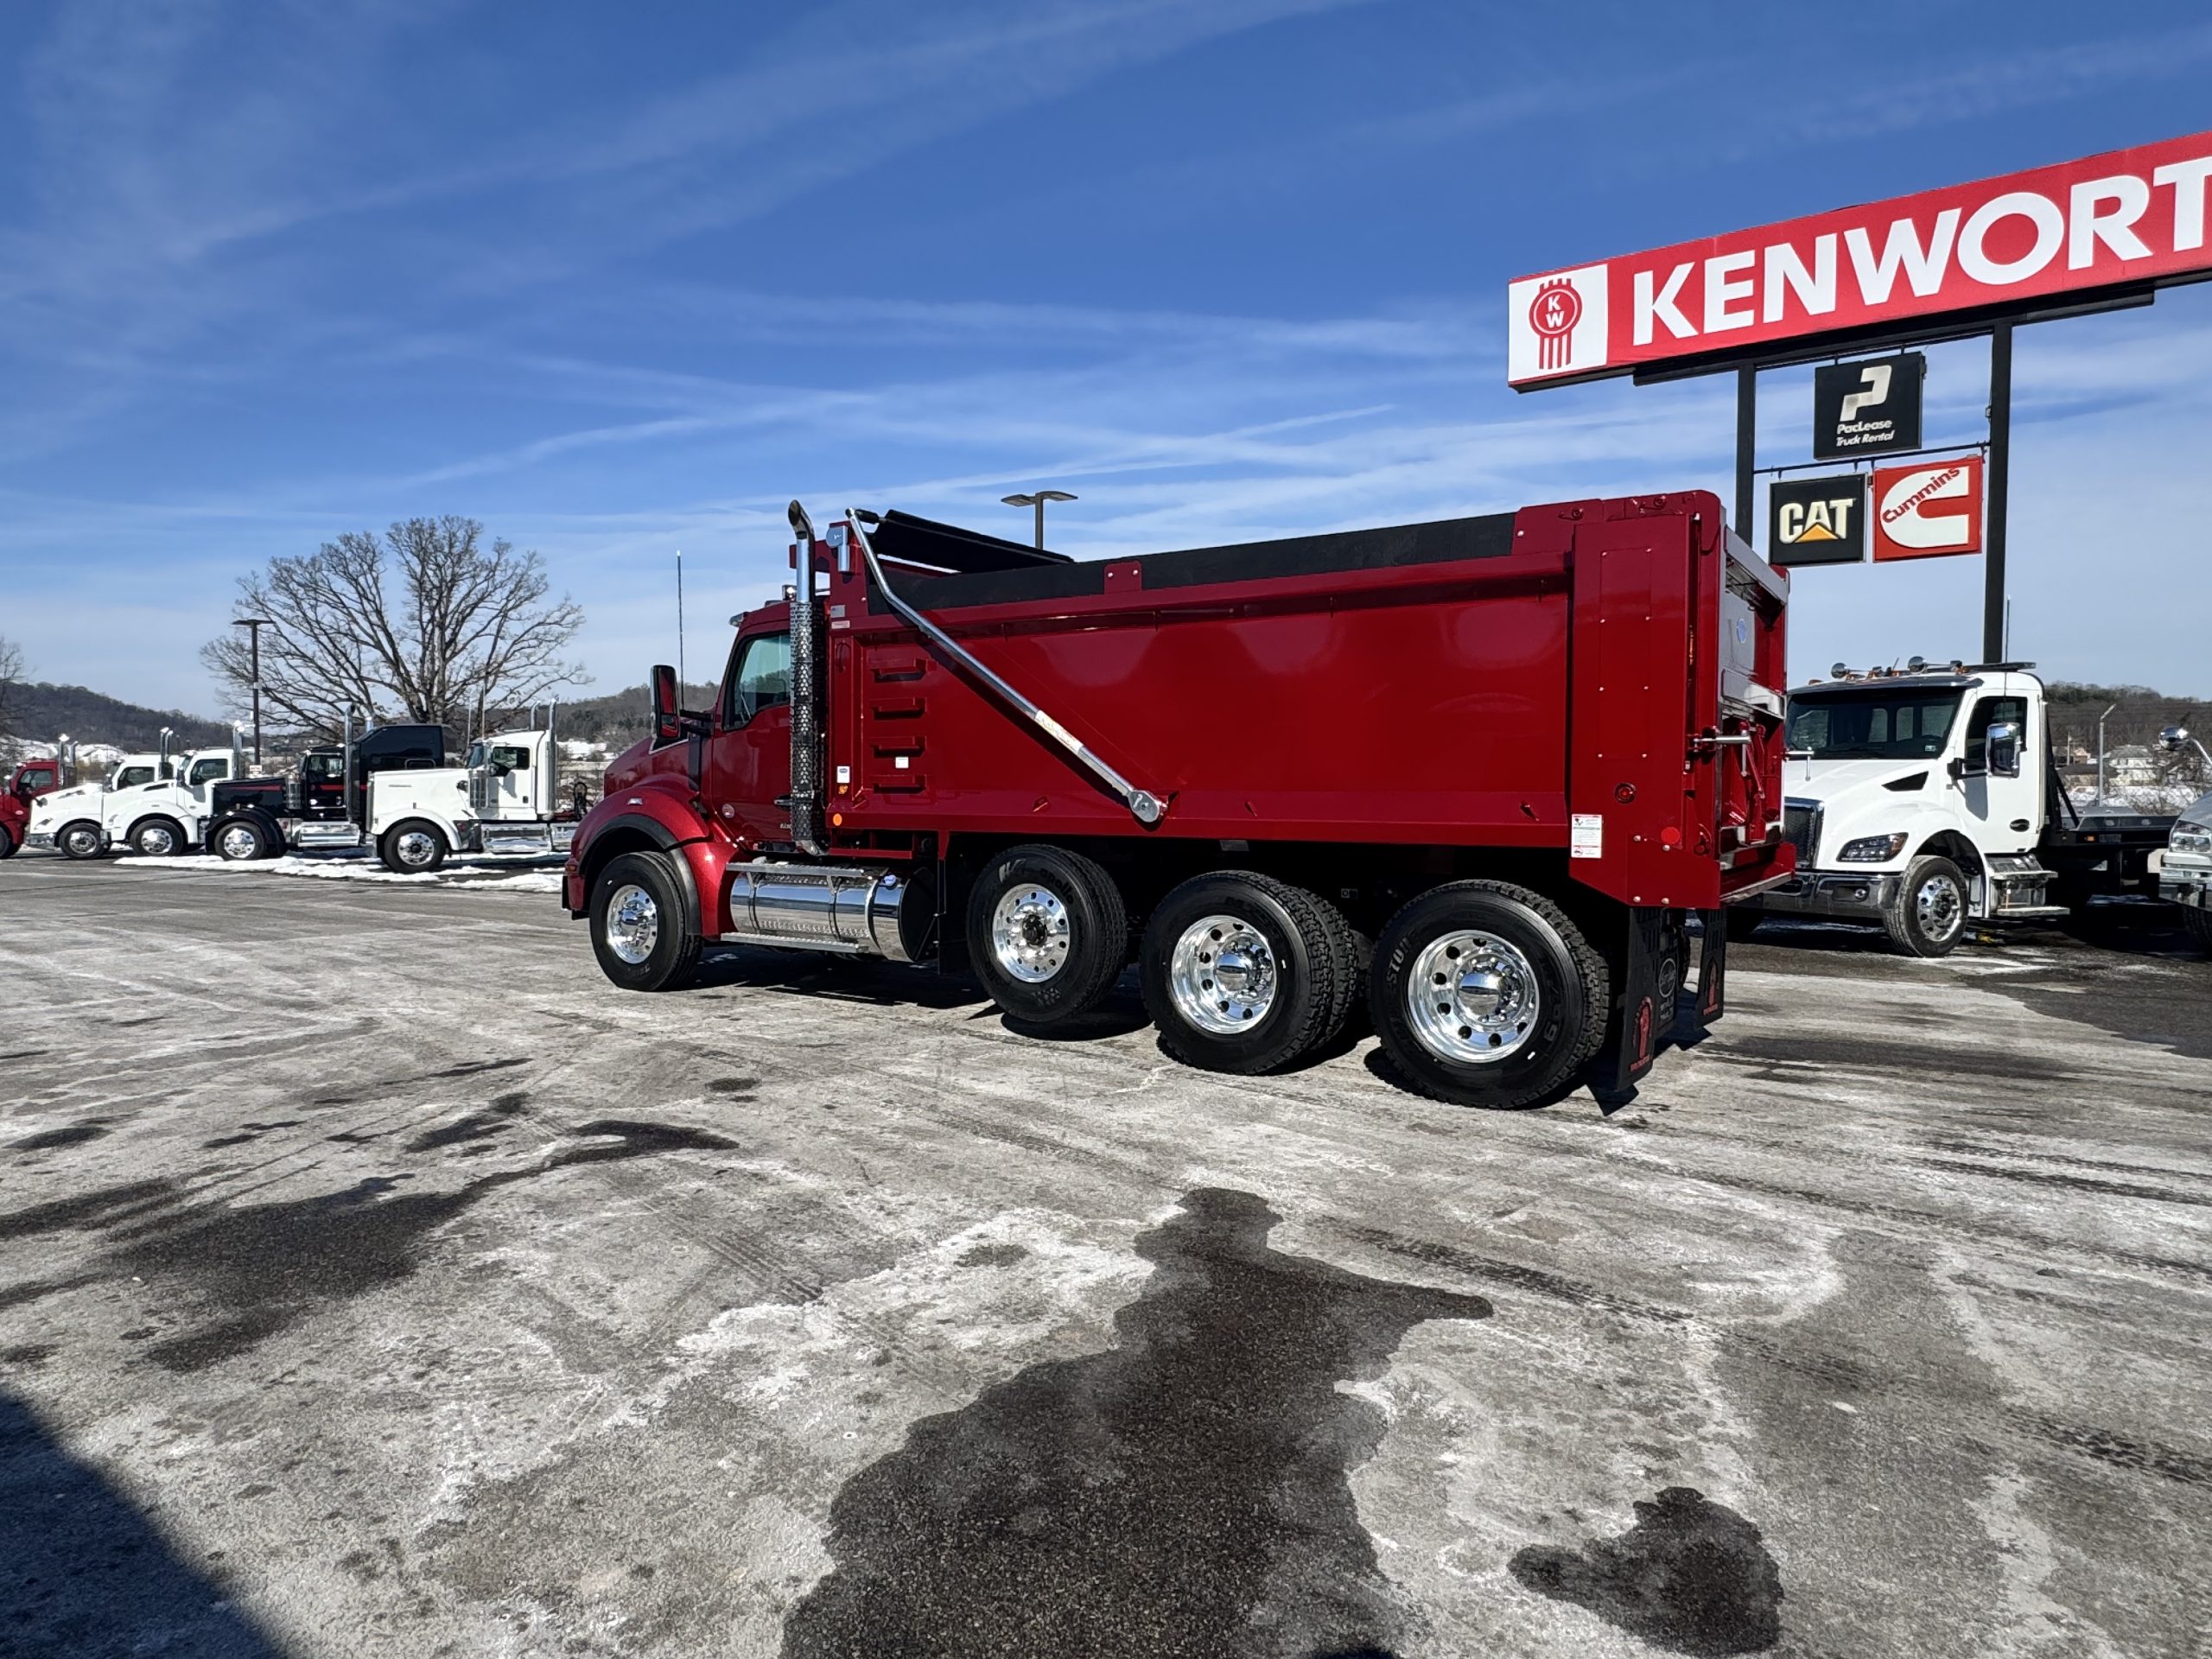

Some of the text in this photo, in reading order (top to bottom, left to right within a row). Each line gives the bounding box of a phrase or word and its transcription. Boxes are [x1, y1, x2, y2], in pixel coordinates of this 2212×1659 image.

[1632, 156, 2212, 346] KENWORT
[1548, 295, 1561, 311] K
[1545, 310, 1565, 328] W
[1836, 429, 1896, 447] Truck Rental
[1837, 420, 1892, 435] PacLease
[1881, 467, 1961, 524] Cummins
[1778, 498, 1857, 543] CAT
[1039, 868, 1075, 906] apollo
